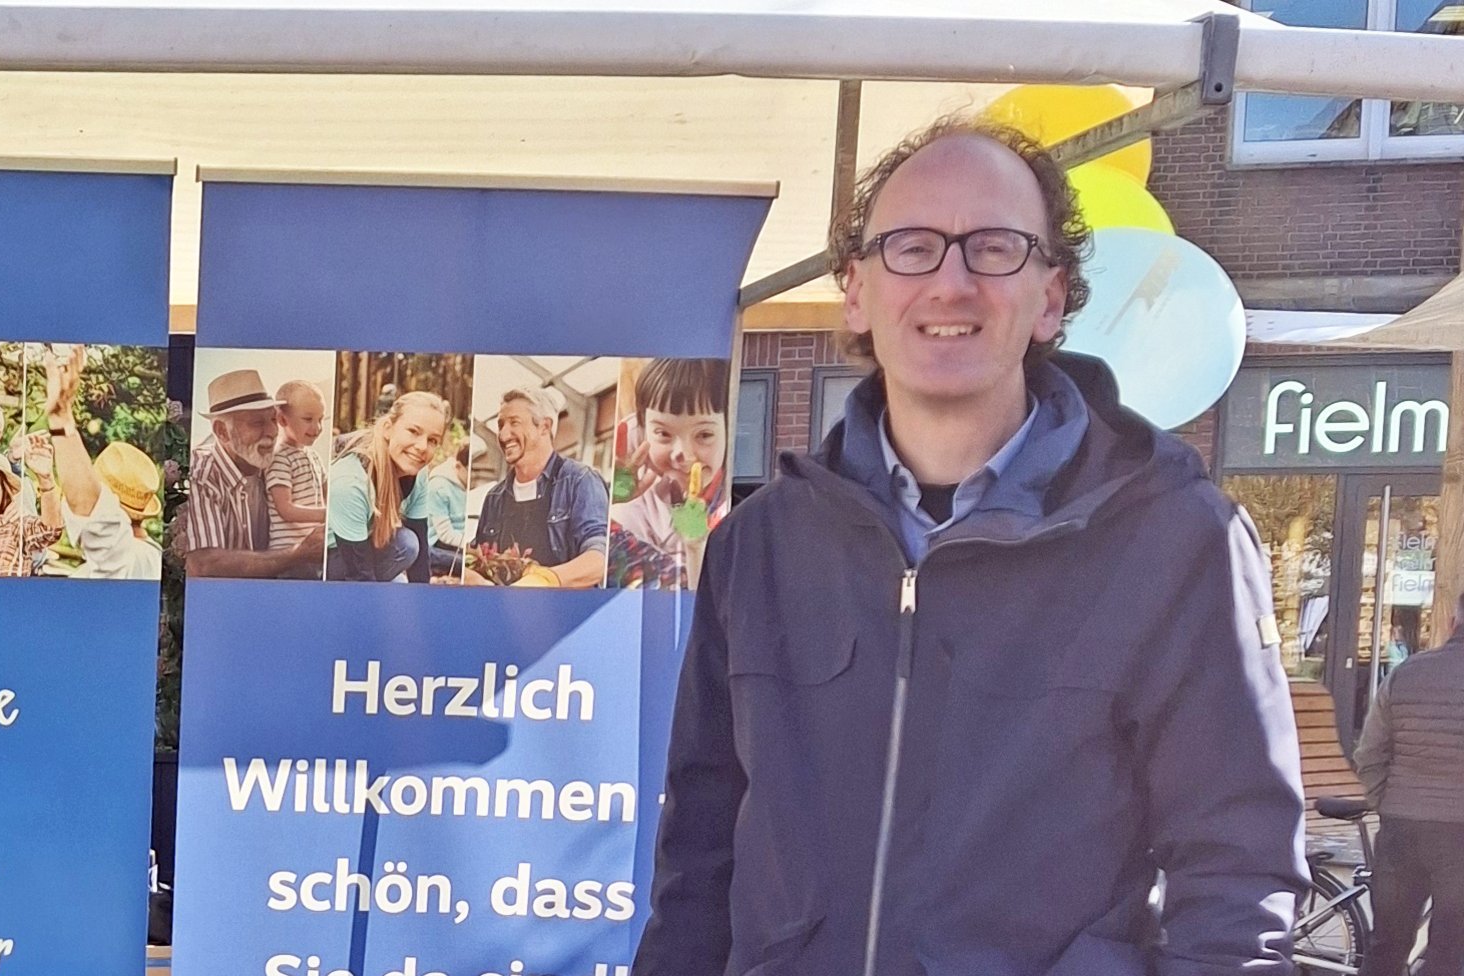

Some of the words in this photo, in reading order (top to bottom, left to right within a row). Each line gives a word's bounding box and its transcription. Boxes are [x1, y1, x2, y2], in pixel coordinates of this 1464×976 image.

[1263, 380, 1450, 454] fielm
[332, 660, 594, 721] Herzlich
[223, 757, 635, 822] Willkommen
[267, 858, 470, 924] schön,
[490, 862, 636, 921] dass
